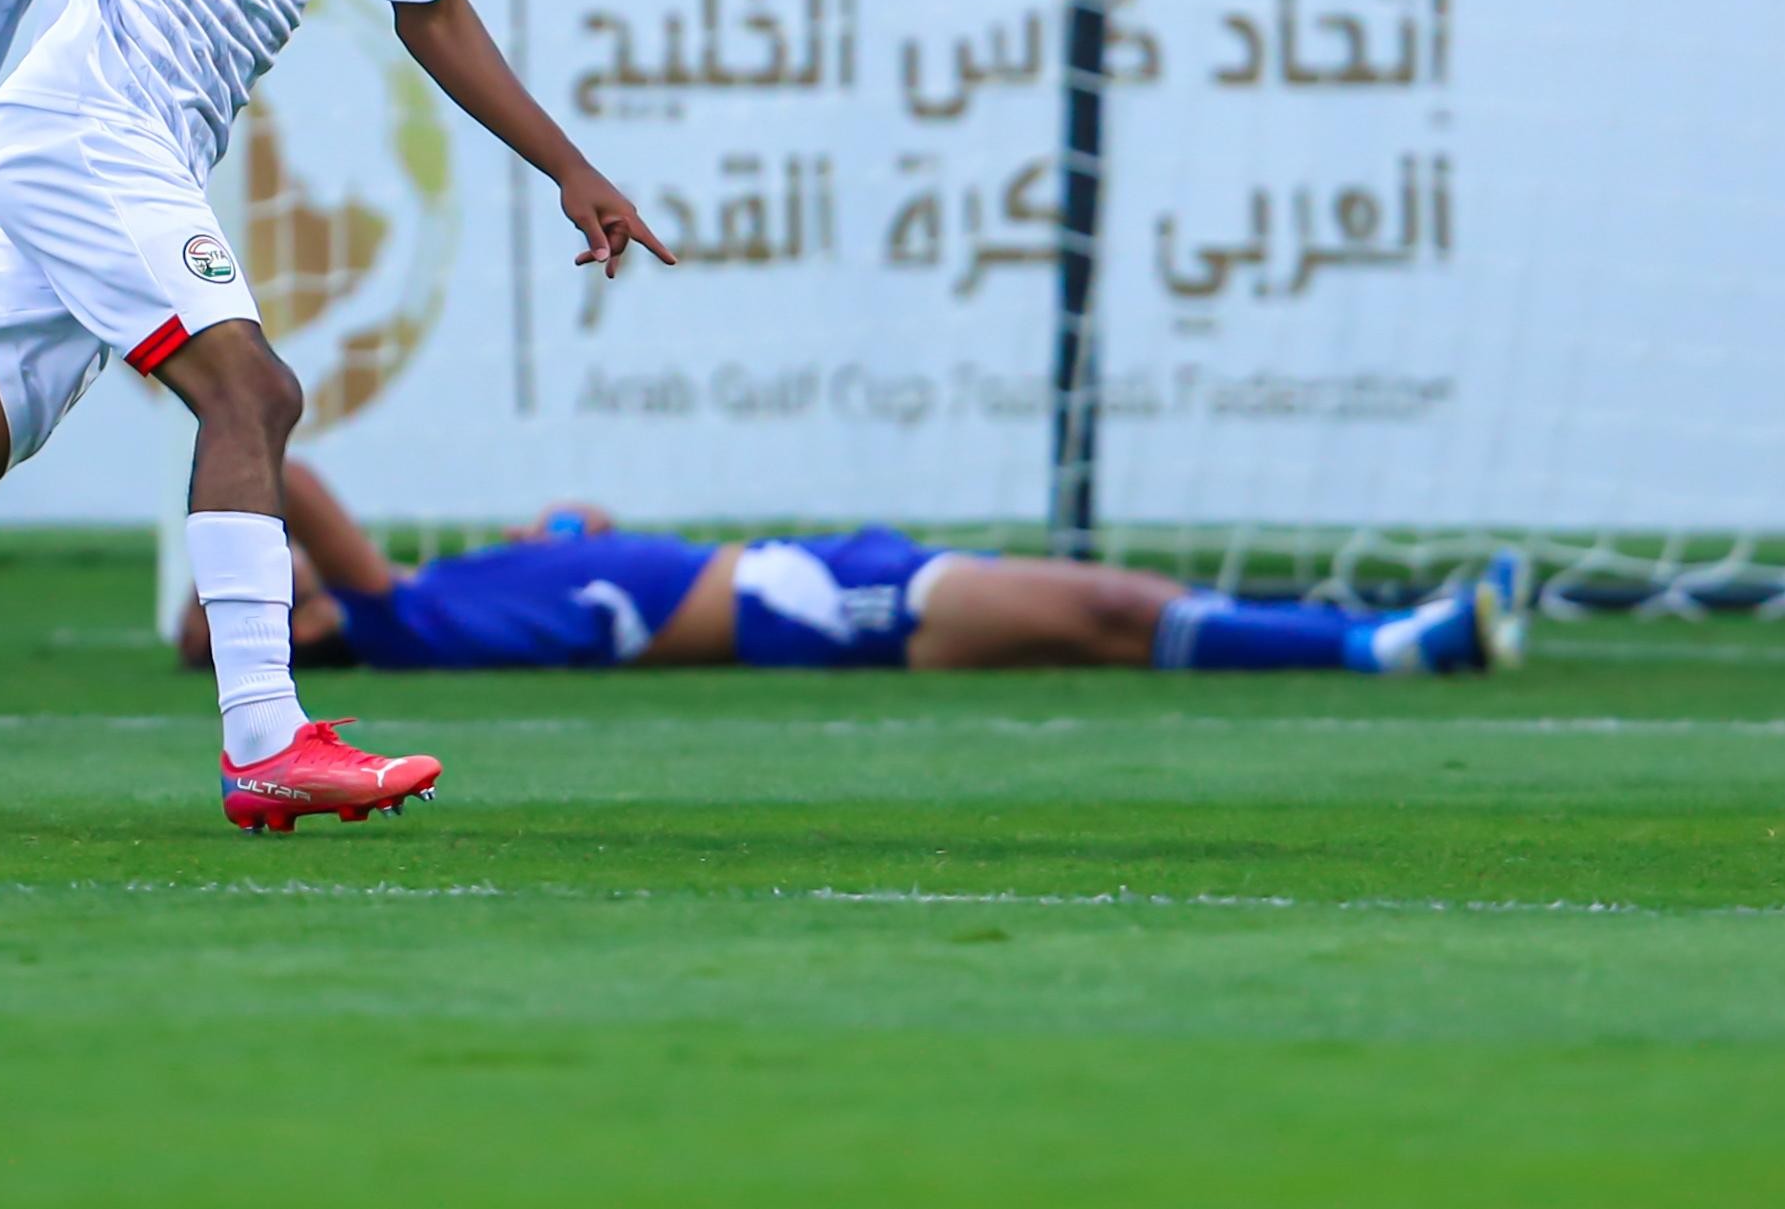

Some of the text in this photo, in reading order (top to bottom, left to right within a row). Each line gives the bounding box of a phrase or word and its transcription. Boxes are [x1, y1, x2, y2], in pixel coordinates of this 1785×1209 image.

[887, 153, 1096, 297] كرة
[1154, 153, 1454, 333] العربي
[829, 362, 936, 431] Cup
[236, 777, 312, 802] ULTRA
